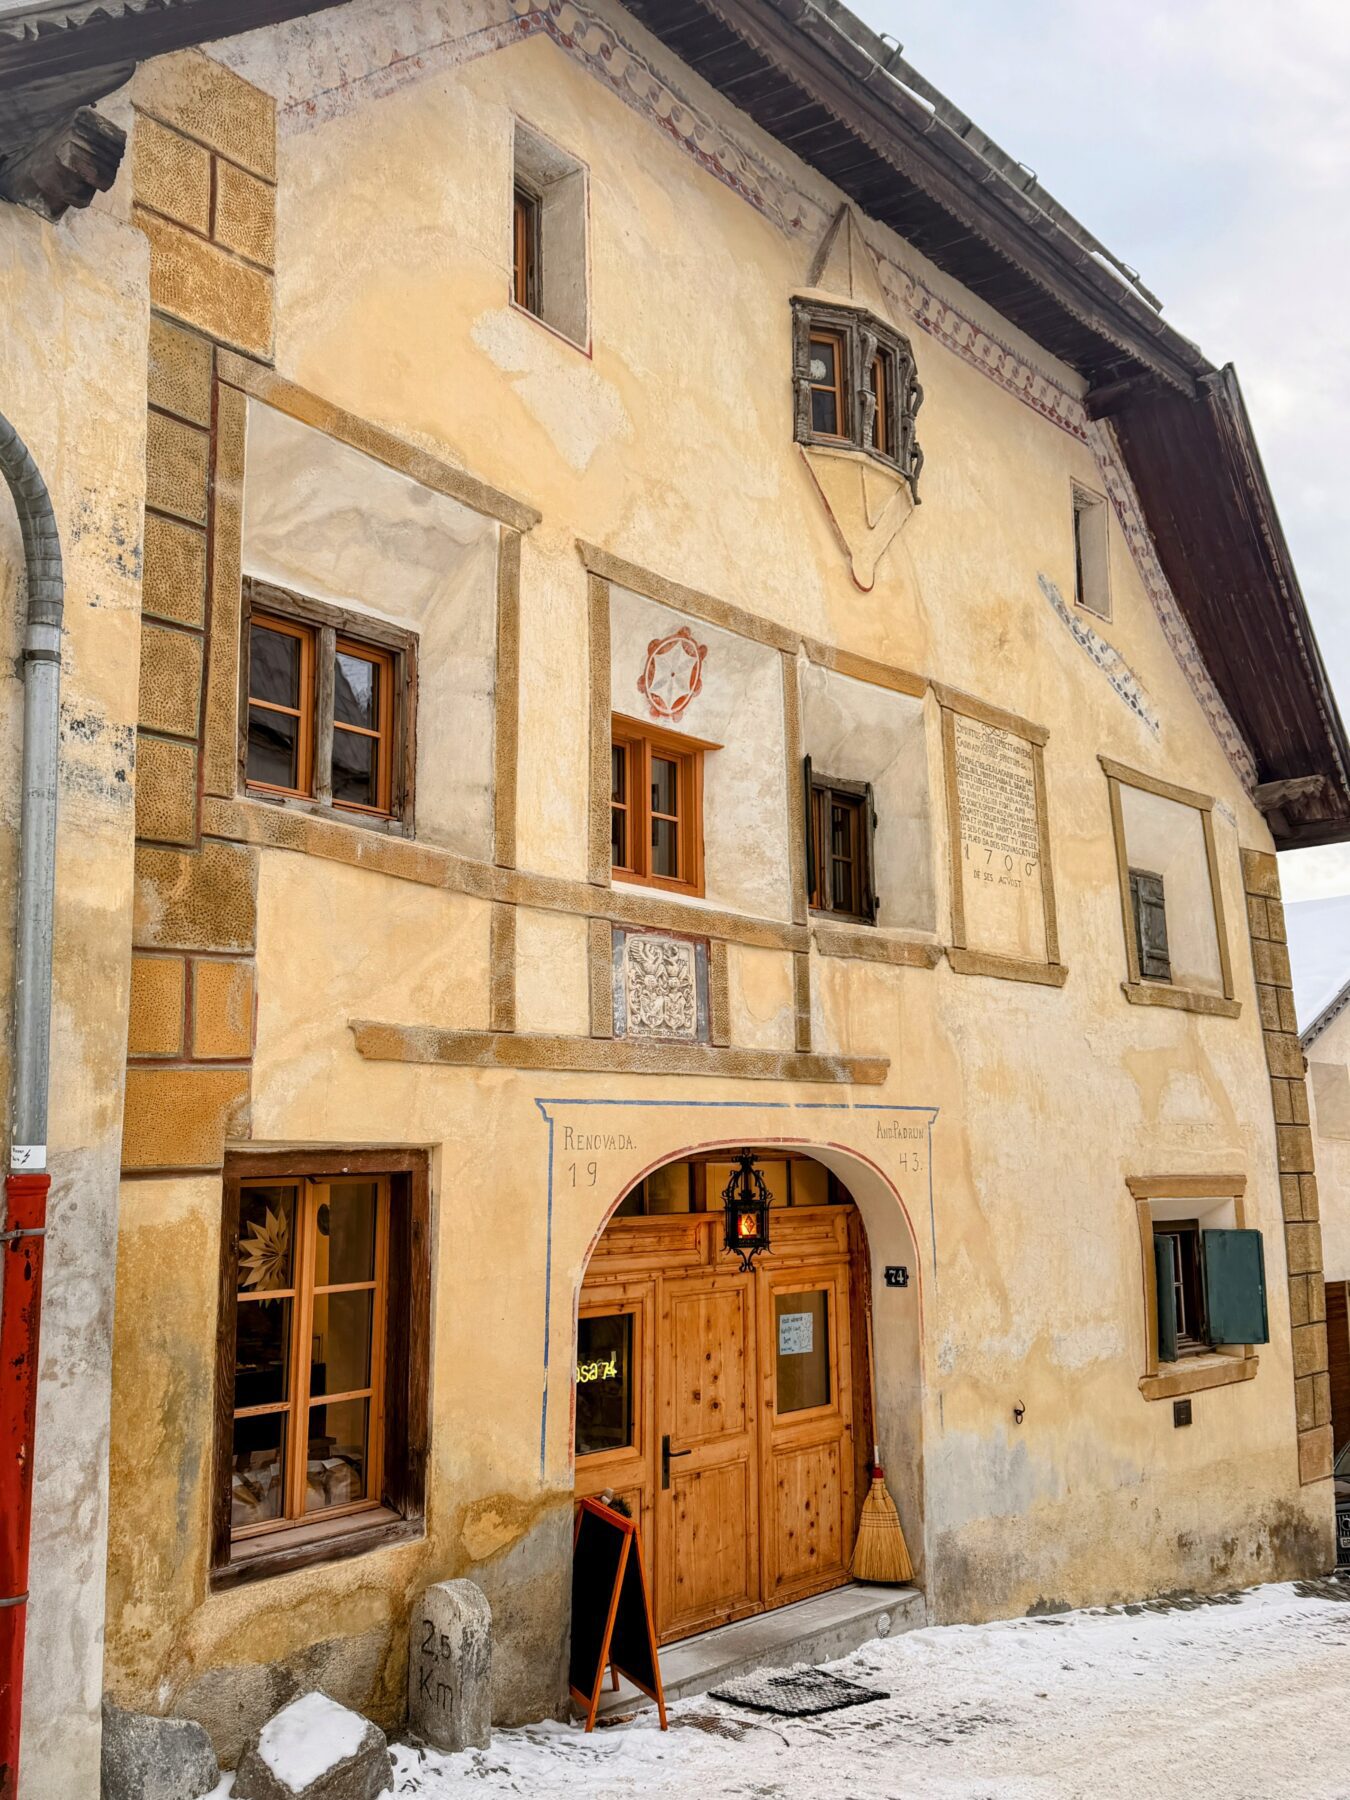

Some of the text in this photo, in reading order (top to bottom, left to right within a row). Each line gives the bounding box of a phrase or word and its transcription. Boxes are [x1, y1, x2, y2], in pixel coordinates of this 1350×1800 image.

[889, 1269, 904, 1283] 74
[421, 1619, 450, 1662] 2,5
[419, 1666, 453, 1712] Km
